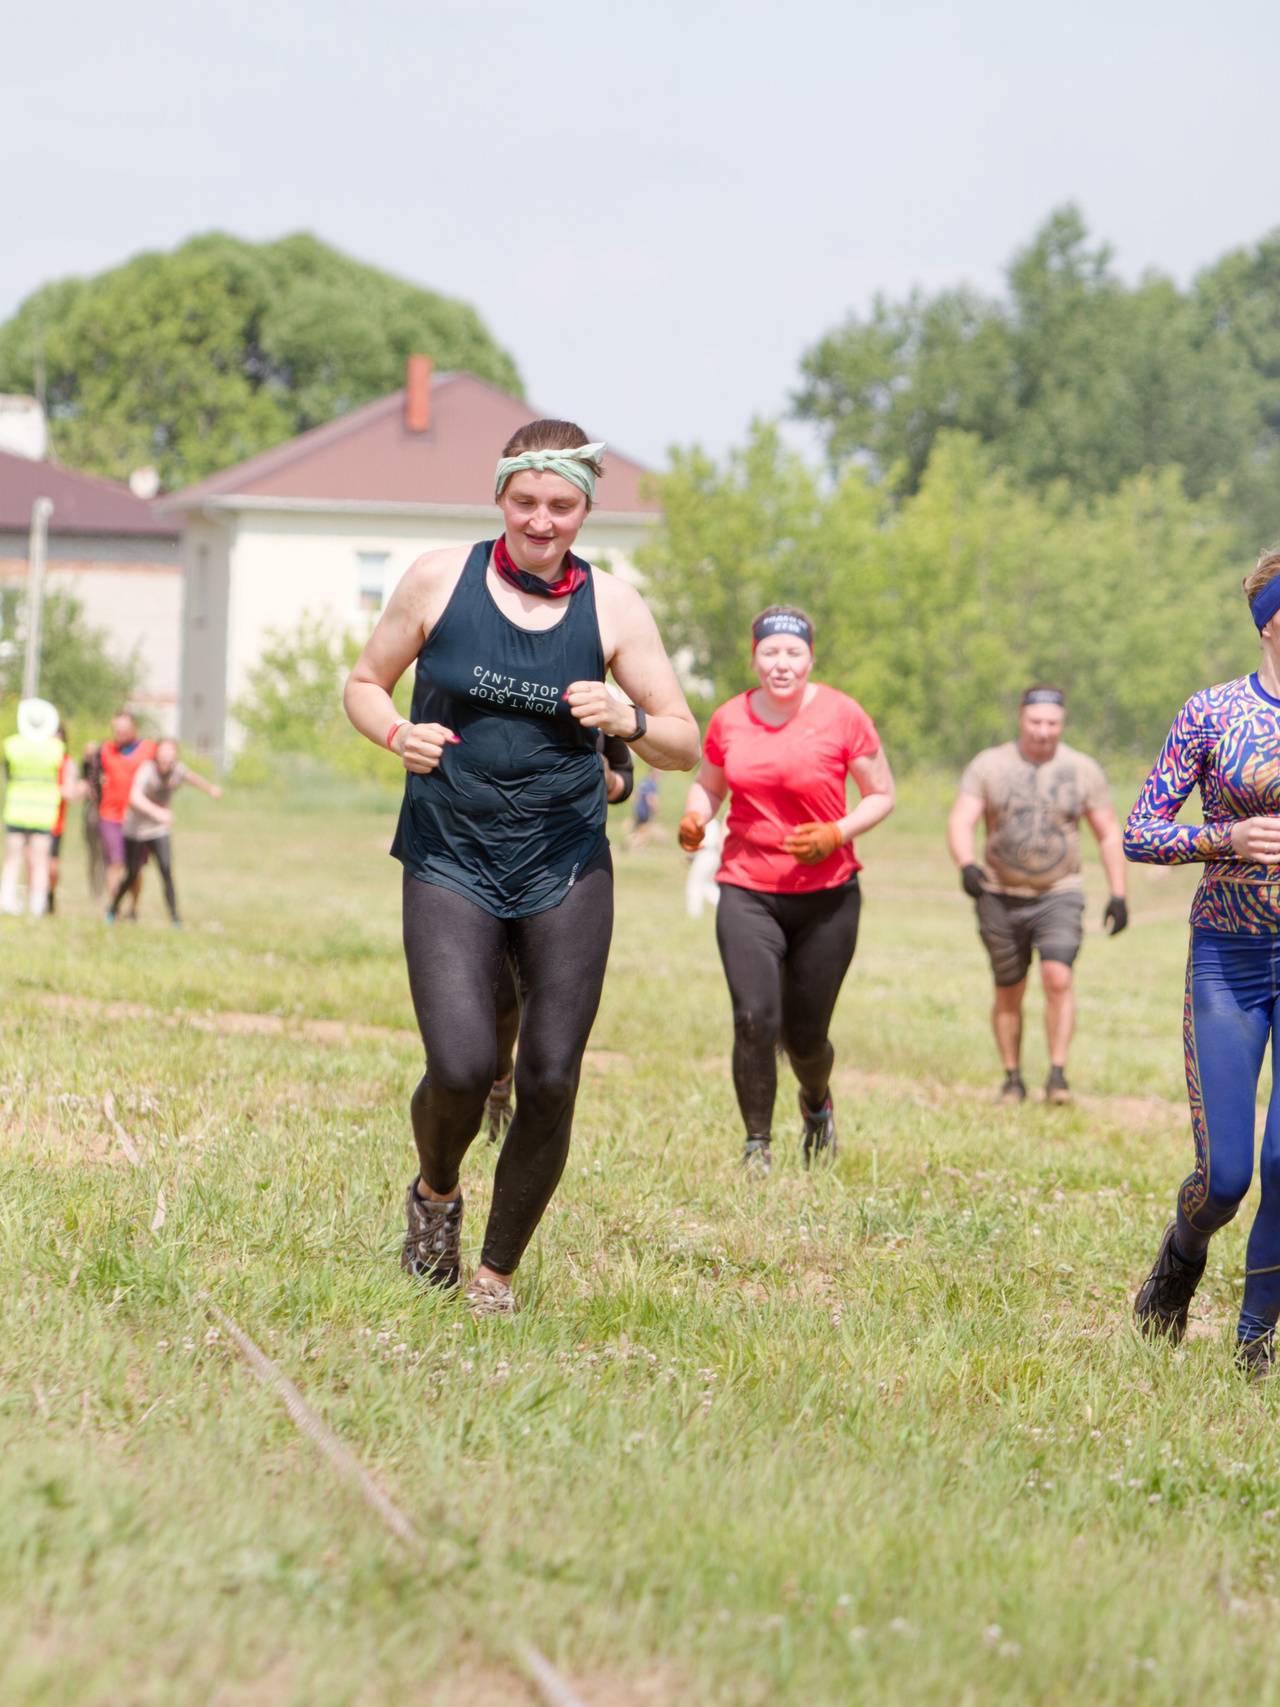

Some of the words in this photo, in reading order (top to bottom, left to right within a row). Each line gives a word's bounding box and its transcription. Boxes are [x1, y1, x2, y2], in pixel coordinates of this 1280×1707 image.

[473, 665, 516, 688] CAN'T
[521, 681, 559, 698] STOP
[469, 686, 506, 704] STOP
[510, 698, 558, 716] WON'T
